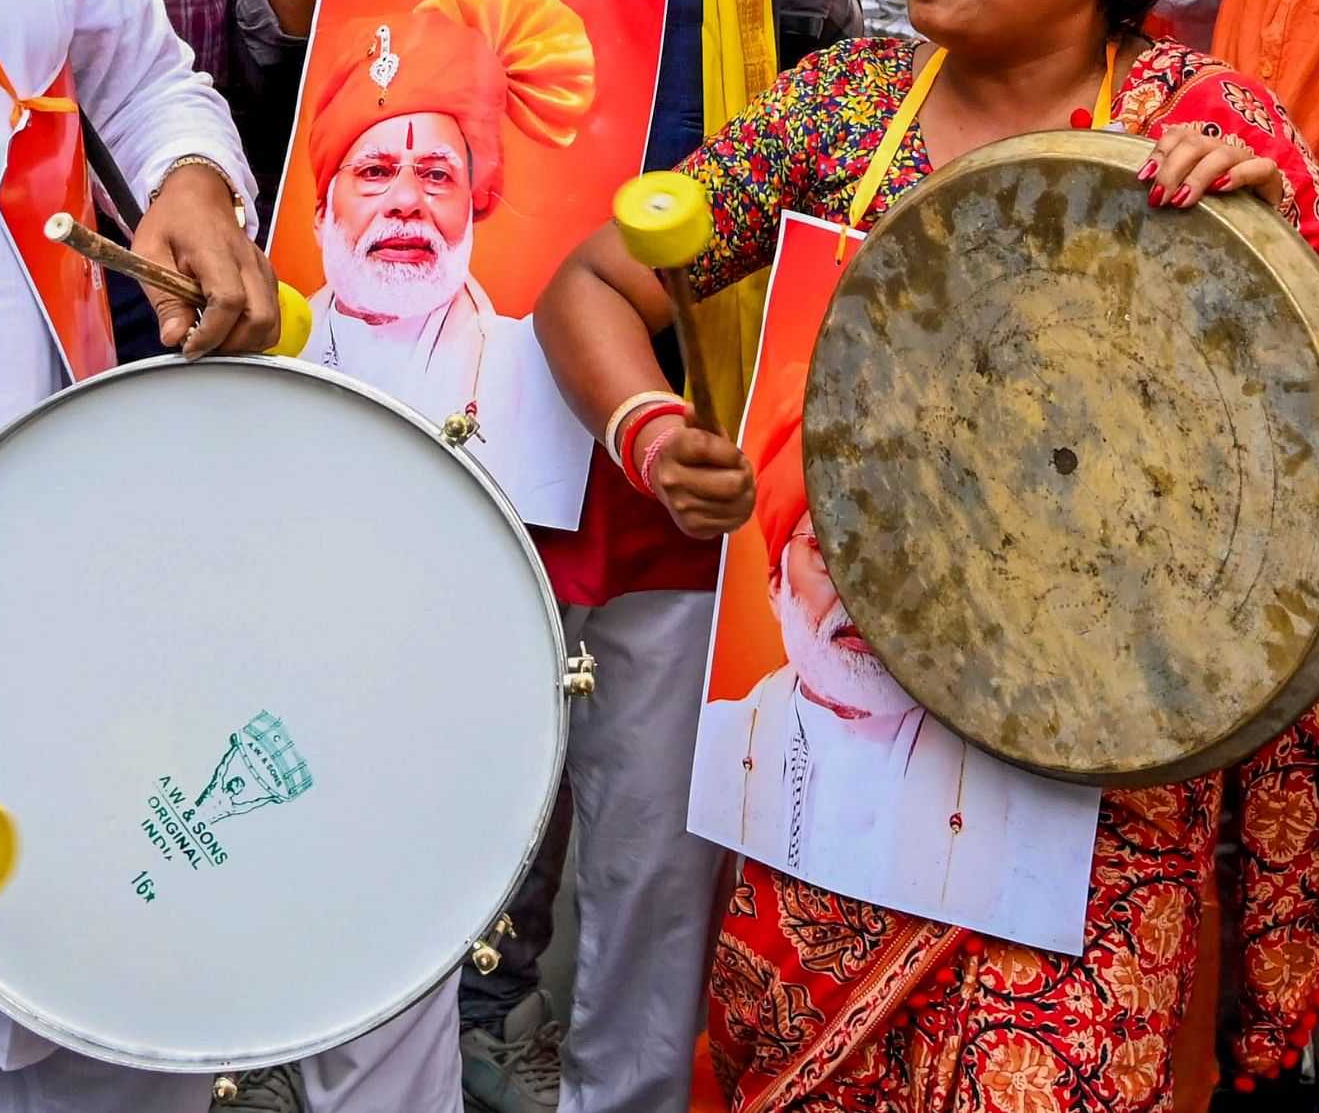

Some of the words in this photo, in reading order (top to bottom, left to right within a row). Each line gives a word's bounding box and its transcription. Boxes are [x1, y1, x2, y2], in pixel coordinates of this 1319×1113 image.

[148, 796, 201, 870] ORIGINAL
[159, 776, 186, 808] A.W.
[182, 809, 195, 822] &
[192, 822, 228, 865] SONS
